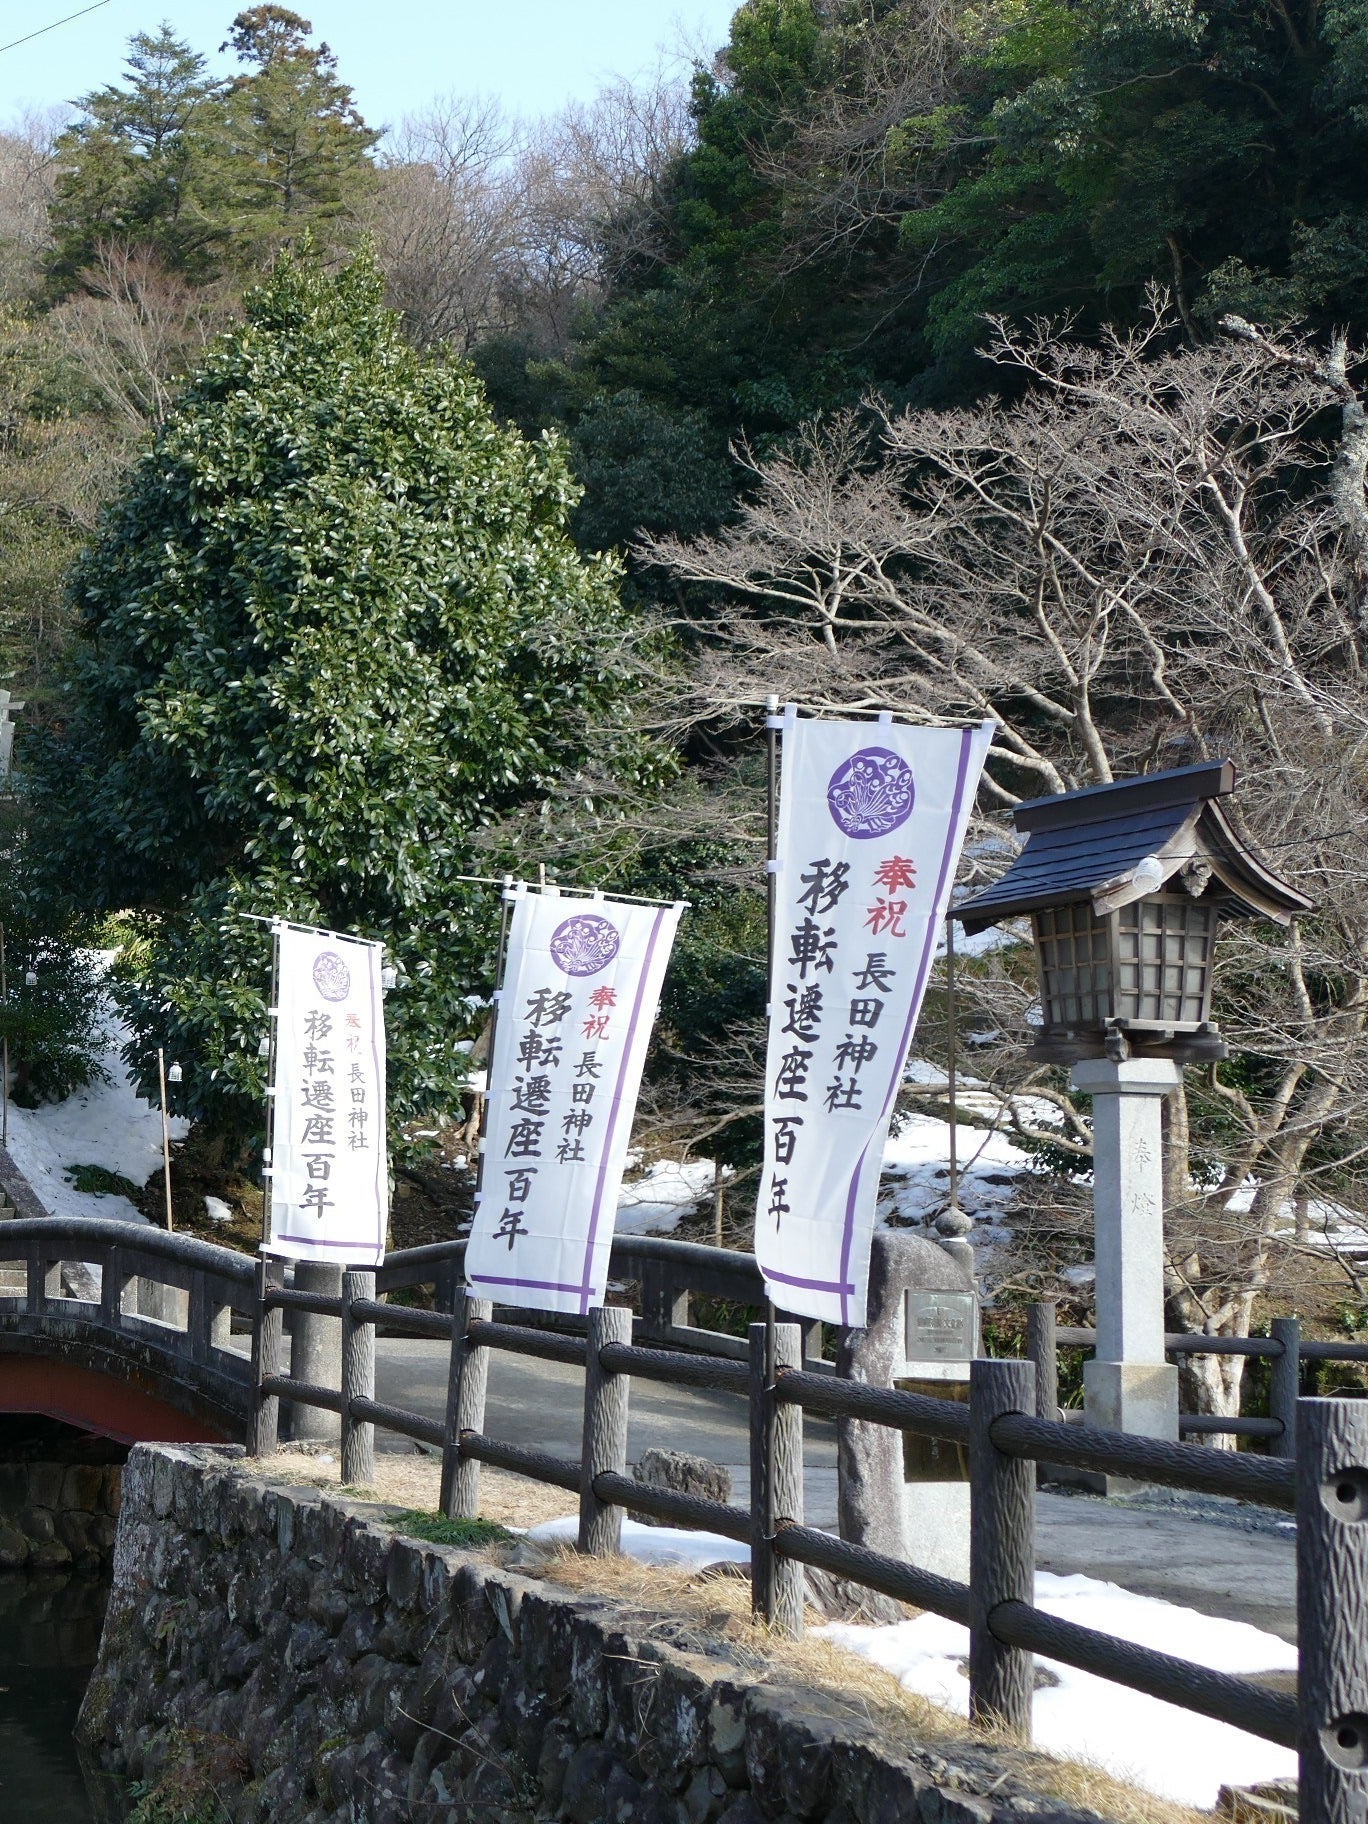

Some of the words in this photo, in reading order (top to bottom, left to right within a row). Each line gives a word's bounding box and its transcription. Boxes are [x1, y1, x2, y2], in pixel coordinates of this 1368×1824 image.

[863, 856, 917, 938] 奉祝
[580, 985, 617, 1040] 奉祝
[767, 857, 850, 1234] 移転遷座百年
[823, 951, 897, 1113] 長田神社
[299, 1009, 336, 1219] 移転遷座百年
[346, 1063, 369, 1151] 長田神社
[492, 986, 572, 1251] 移転遷座百年
[555, 1051, 603, 1164] 長田神社
